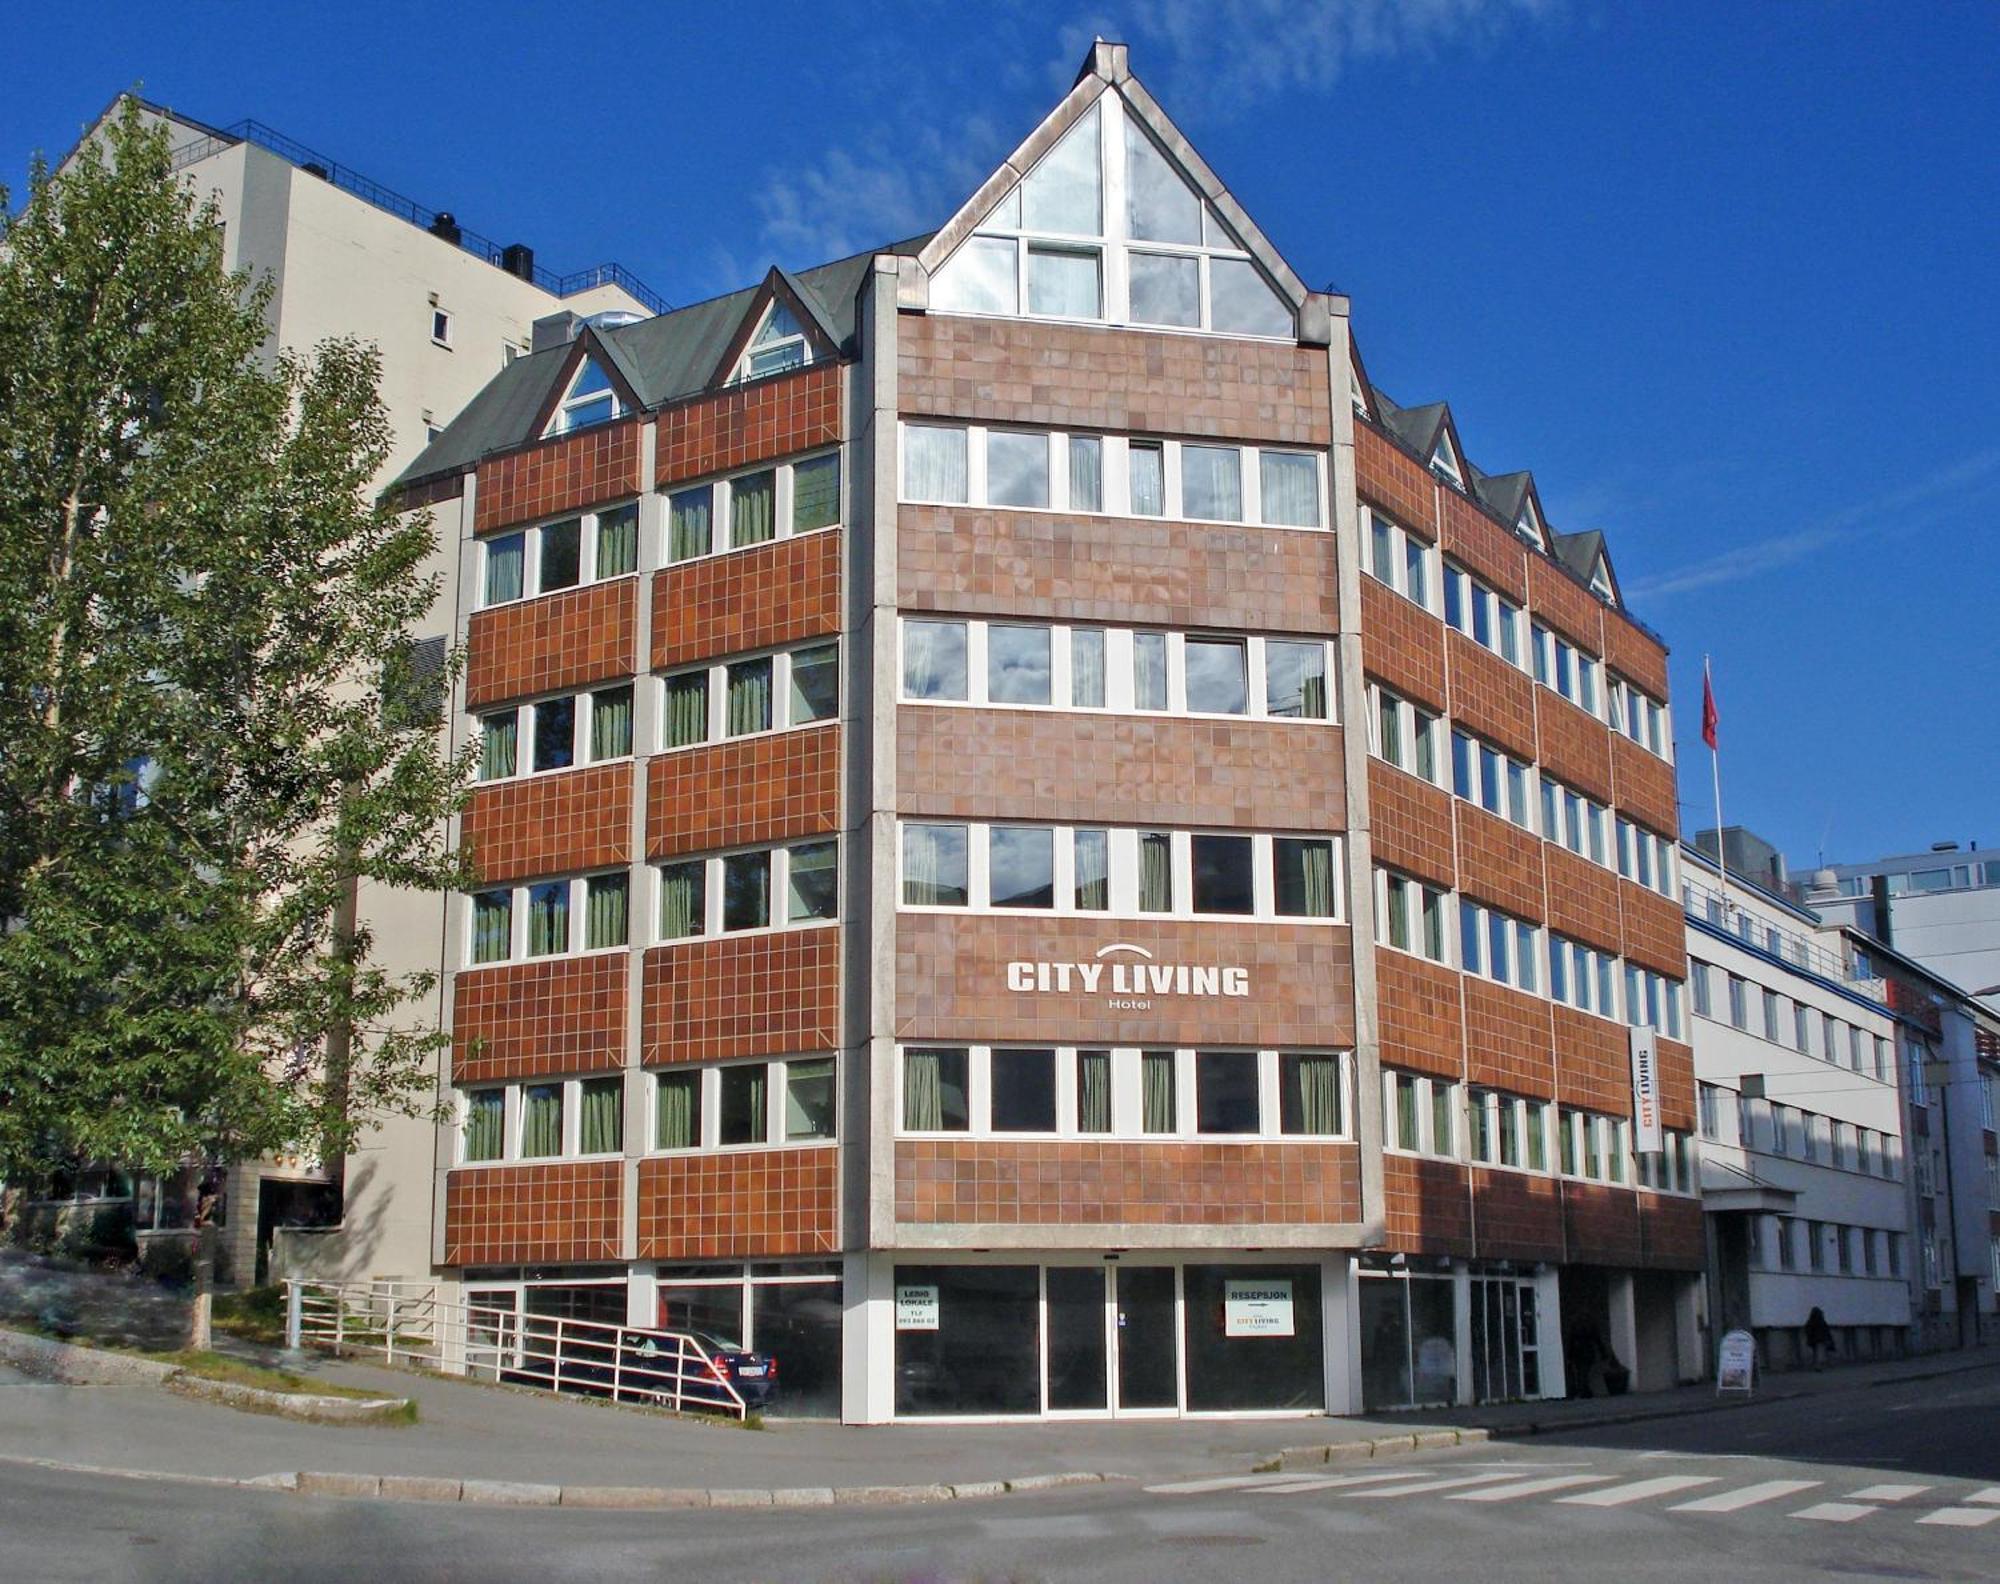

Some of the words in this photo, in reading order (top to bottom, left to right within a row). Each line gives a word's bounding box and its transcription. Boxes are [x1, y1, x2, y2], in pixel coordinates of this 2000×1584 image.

[1007, 961, 1103, 993] CITY
[1112, 964, 1249, 996] LIVING
[1108, 999, 1151, 1010] Hotel
[1638, 1049, 1650, 1095] LIVING
[1641, 1097, 1652, 1128] CITY
[900, 1299, 933, 1307] LOKALE
[1231, 1290, 1288, 1300] RESEPSJON
